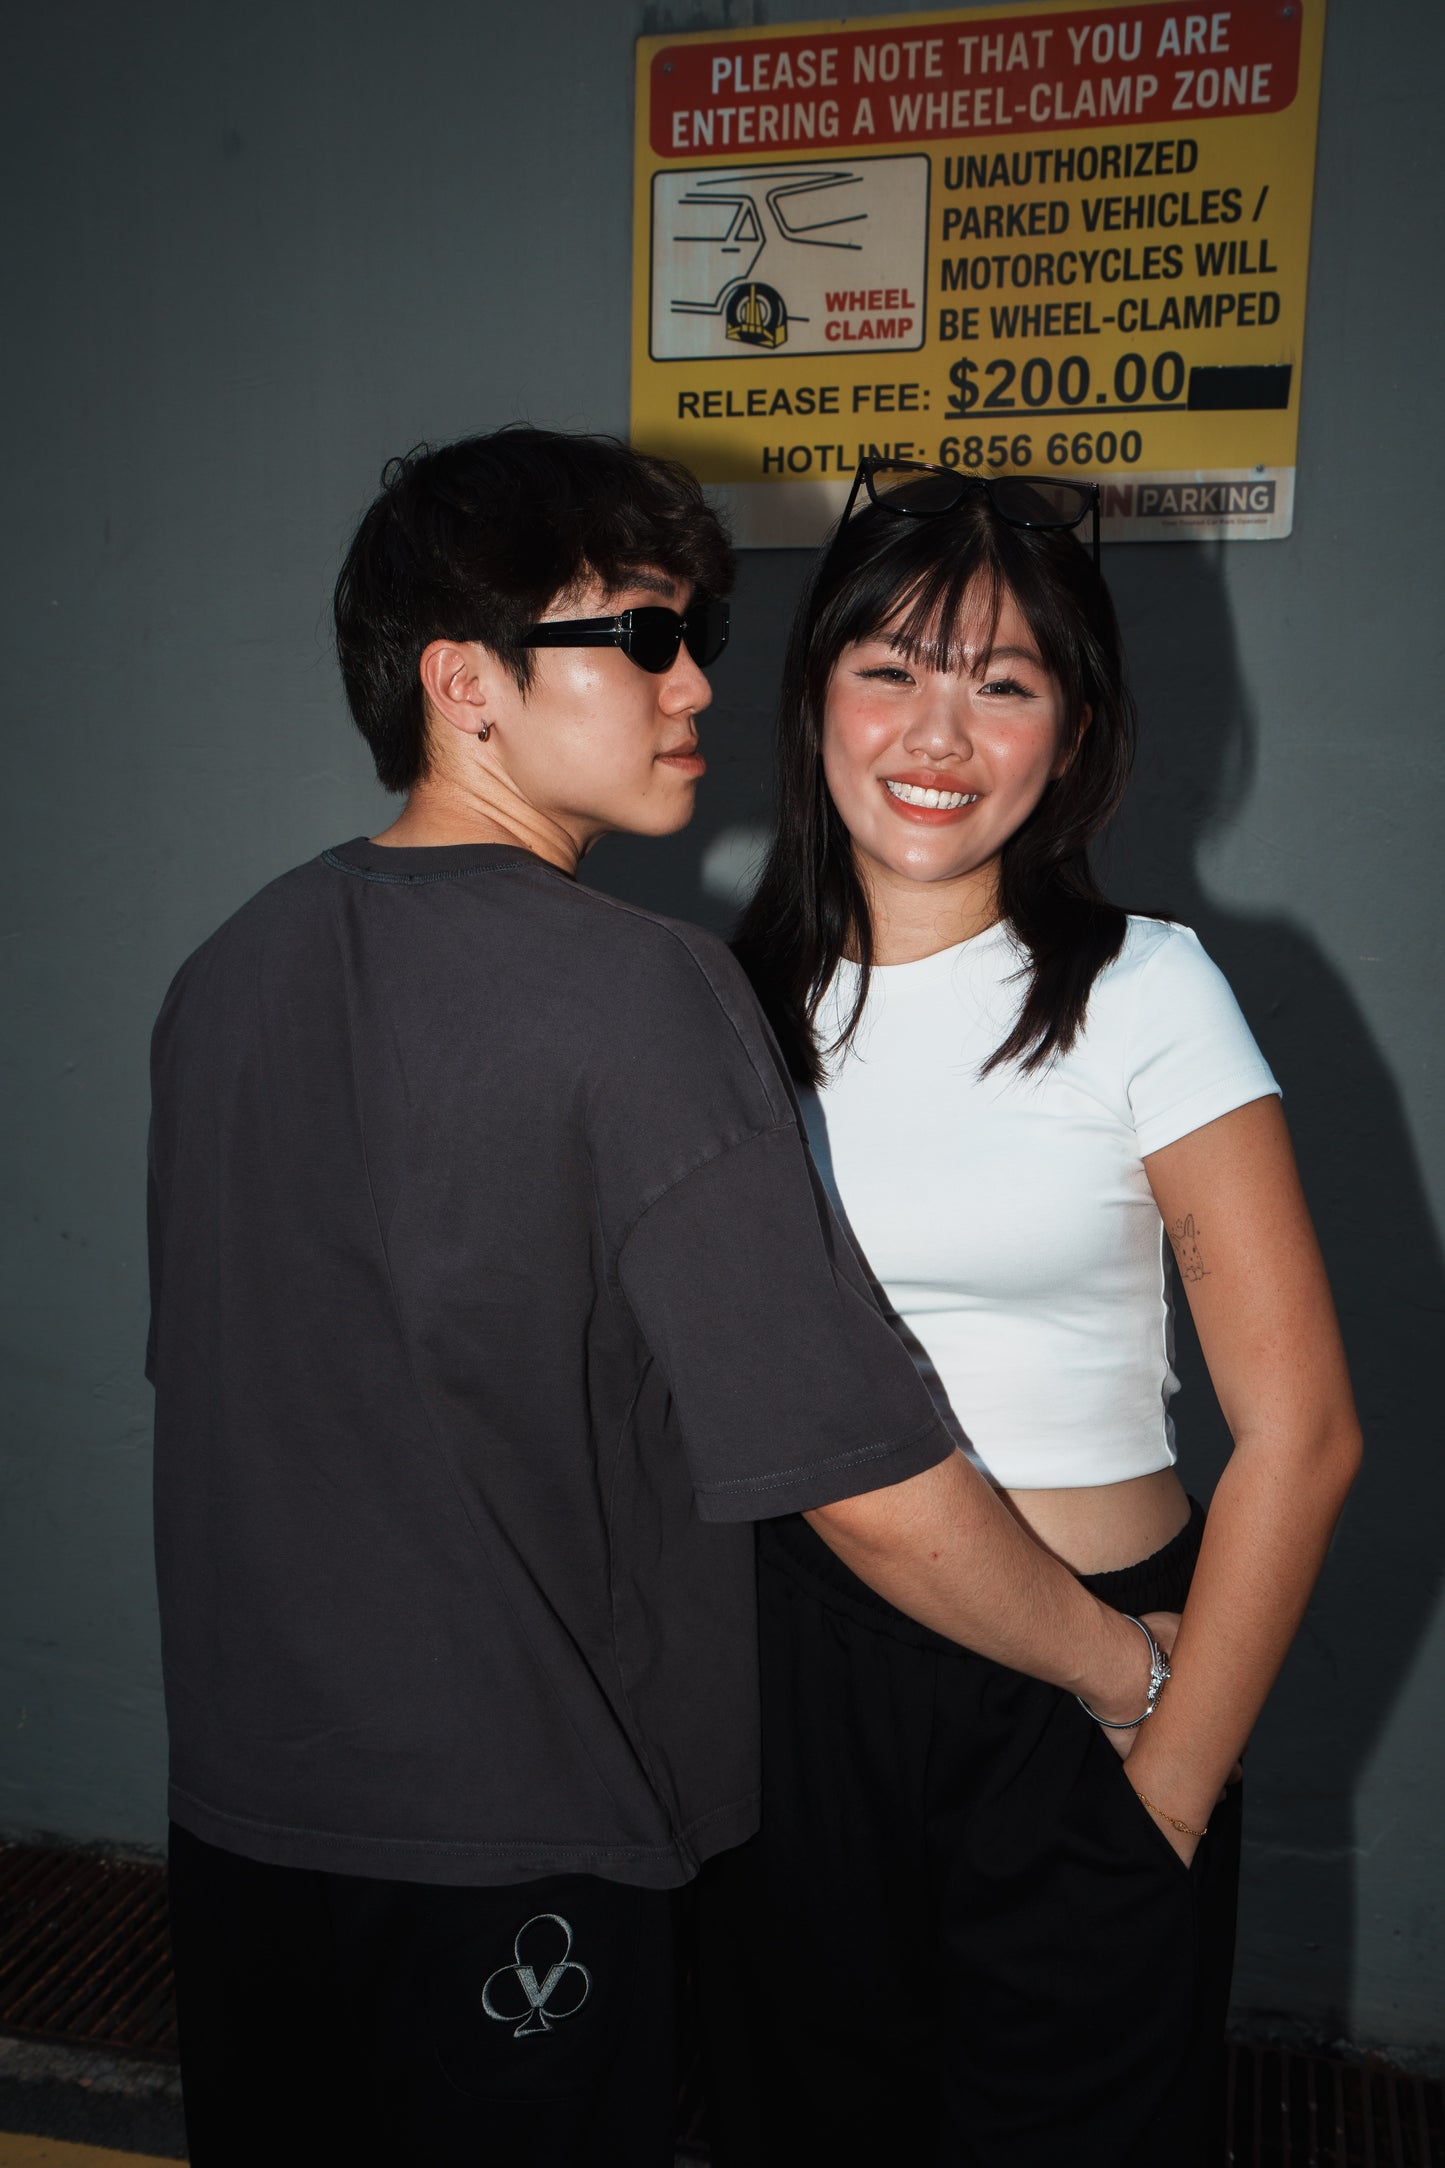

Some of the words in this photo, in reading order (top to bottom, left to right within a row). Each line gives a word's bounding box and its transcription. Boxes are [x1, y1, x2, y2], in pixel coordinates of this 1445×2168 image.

[712, 48, 838, 94] PLEASE
[853, 40, 943, 84] NOTE
[958, 30, 1053, 75] THAT
[1067, 21, 1142, 65] YOU
[1156, 12, 1231, 58] ARE
[672, 100, 839, 148] ENTERING
[852, 98, 875, 135] A
[889, 75, 1158, 133] WHEEL-CLAMP
[1172, 63, 1272, 110] ZONE
[944, 139, 1198, 190] UNAUTHORIZED
[942, 201, 1069, 241] PARKED
[1081, 188, 1242, 232] VEHICLES
[1252, 185, 1269, 222] /
[940, 245, 1184, 291] MOTORCYCLES
[1195, 239, 1277, 278] WILL
[825, 288, 915, 313] WHEEL
[939, 308, 979, 341] BE
[990, 291, 1281, 339] WHEEL-CLAMPED
[825, 318, 914, 342] CLAMP
[678, 386, 840, 419] RELEASE
[852, 383, 930, 413] FEE:
[947, 351, 1185, 413] $200.00
[939, 434, 1032, 468] 6856
[1047, 430, 1143, 466] 6600
[1142, 486, 1269, 514] PARKING
